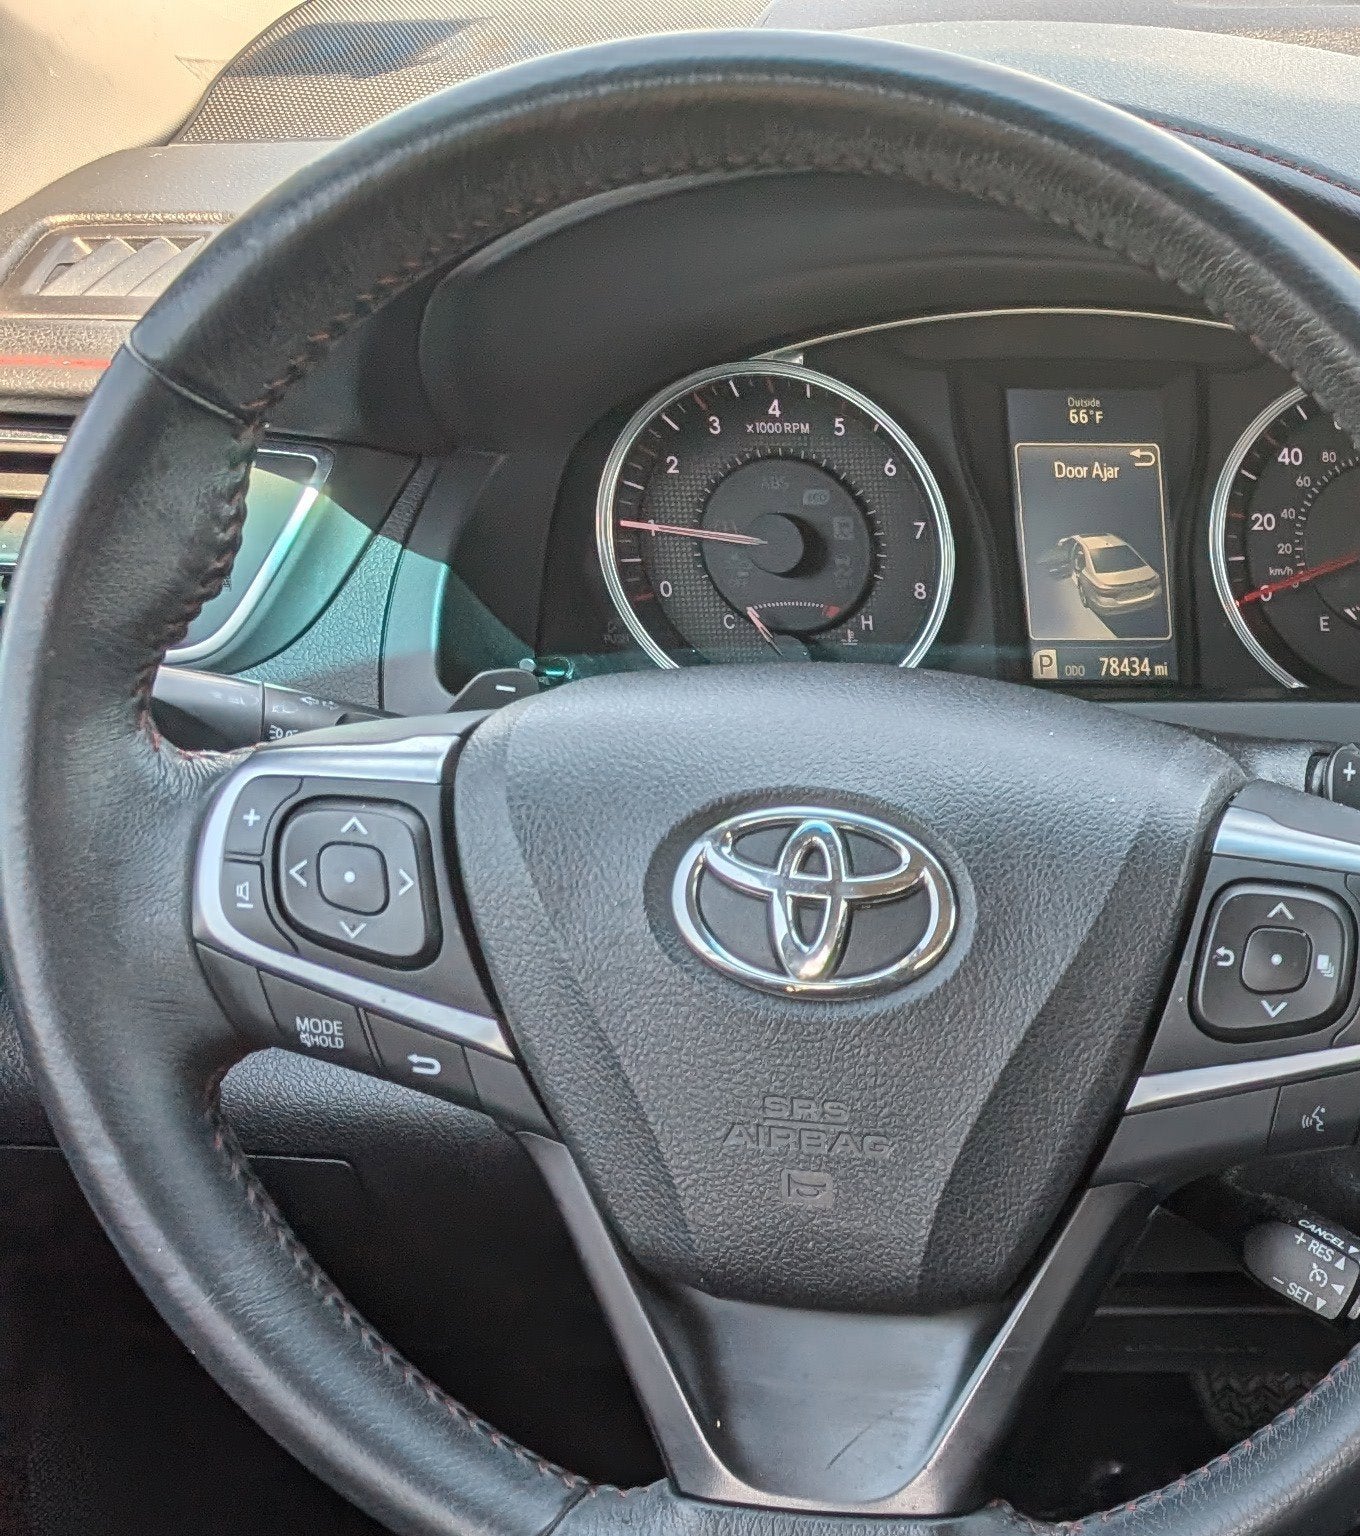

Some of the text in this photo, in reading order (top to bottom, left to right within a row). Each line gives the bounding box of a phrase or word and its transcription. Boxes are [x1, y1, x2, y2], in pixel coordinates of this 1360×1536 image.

[767, 400, 781, 418] 4
[1067, 397, 1101, 409] Outside
[708, 417, 722, 434] 3
[1069, 410, 1104, 425] 66°F
[783, 422, 810, 434] RPM
[833, 418, 846, 436] 5
[666, 456, 680, 474] 2
[1277, 447, 1304, 466] 40
[1321, 451, 1337, 463] 80
[883, 459, 897, 477] 6
[1054, 461, 1120, 483] Door Ajar
[1295, 476, 1311, 488] 60
[1250, 513, 1276, 531] 20
[1280, 508, 1296, 520] 40
[913, 522, 926, 539] 7
[1277, 543, 1293, 555] 20
[1268, 566, 1294, 577] km/h
[659, 581, 673, 598] 0
[913, 583, 927, 600] 8
[723, 615, 736, 630] C
[860, 615, 874, 630] H
[1319, 616, 1331, 632] E
[1099, 657, 1151, 677] 78434
[1154, 662, 1169, 677] mi
[295, 1016, 344, 1037] MODE
[310, 1034, 345, 1050] HOLD
[762, 1095, 850, 1124] SRS
[722, 1124, 893, 1153] AIRBAG
[1297, 1218, 1346, 1251] CANCEL
[1307, 1239, 1334, 1262] RES
[1286, 1282, 1313, 1304] SET
